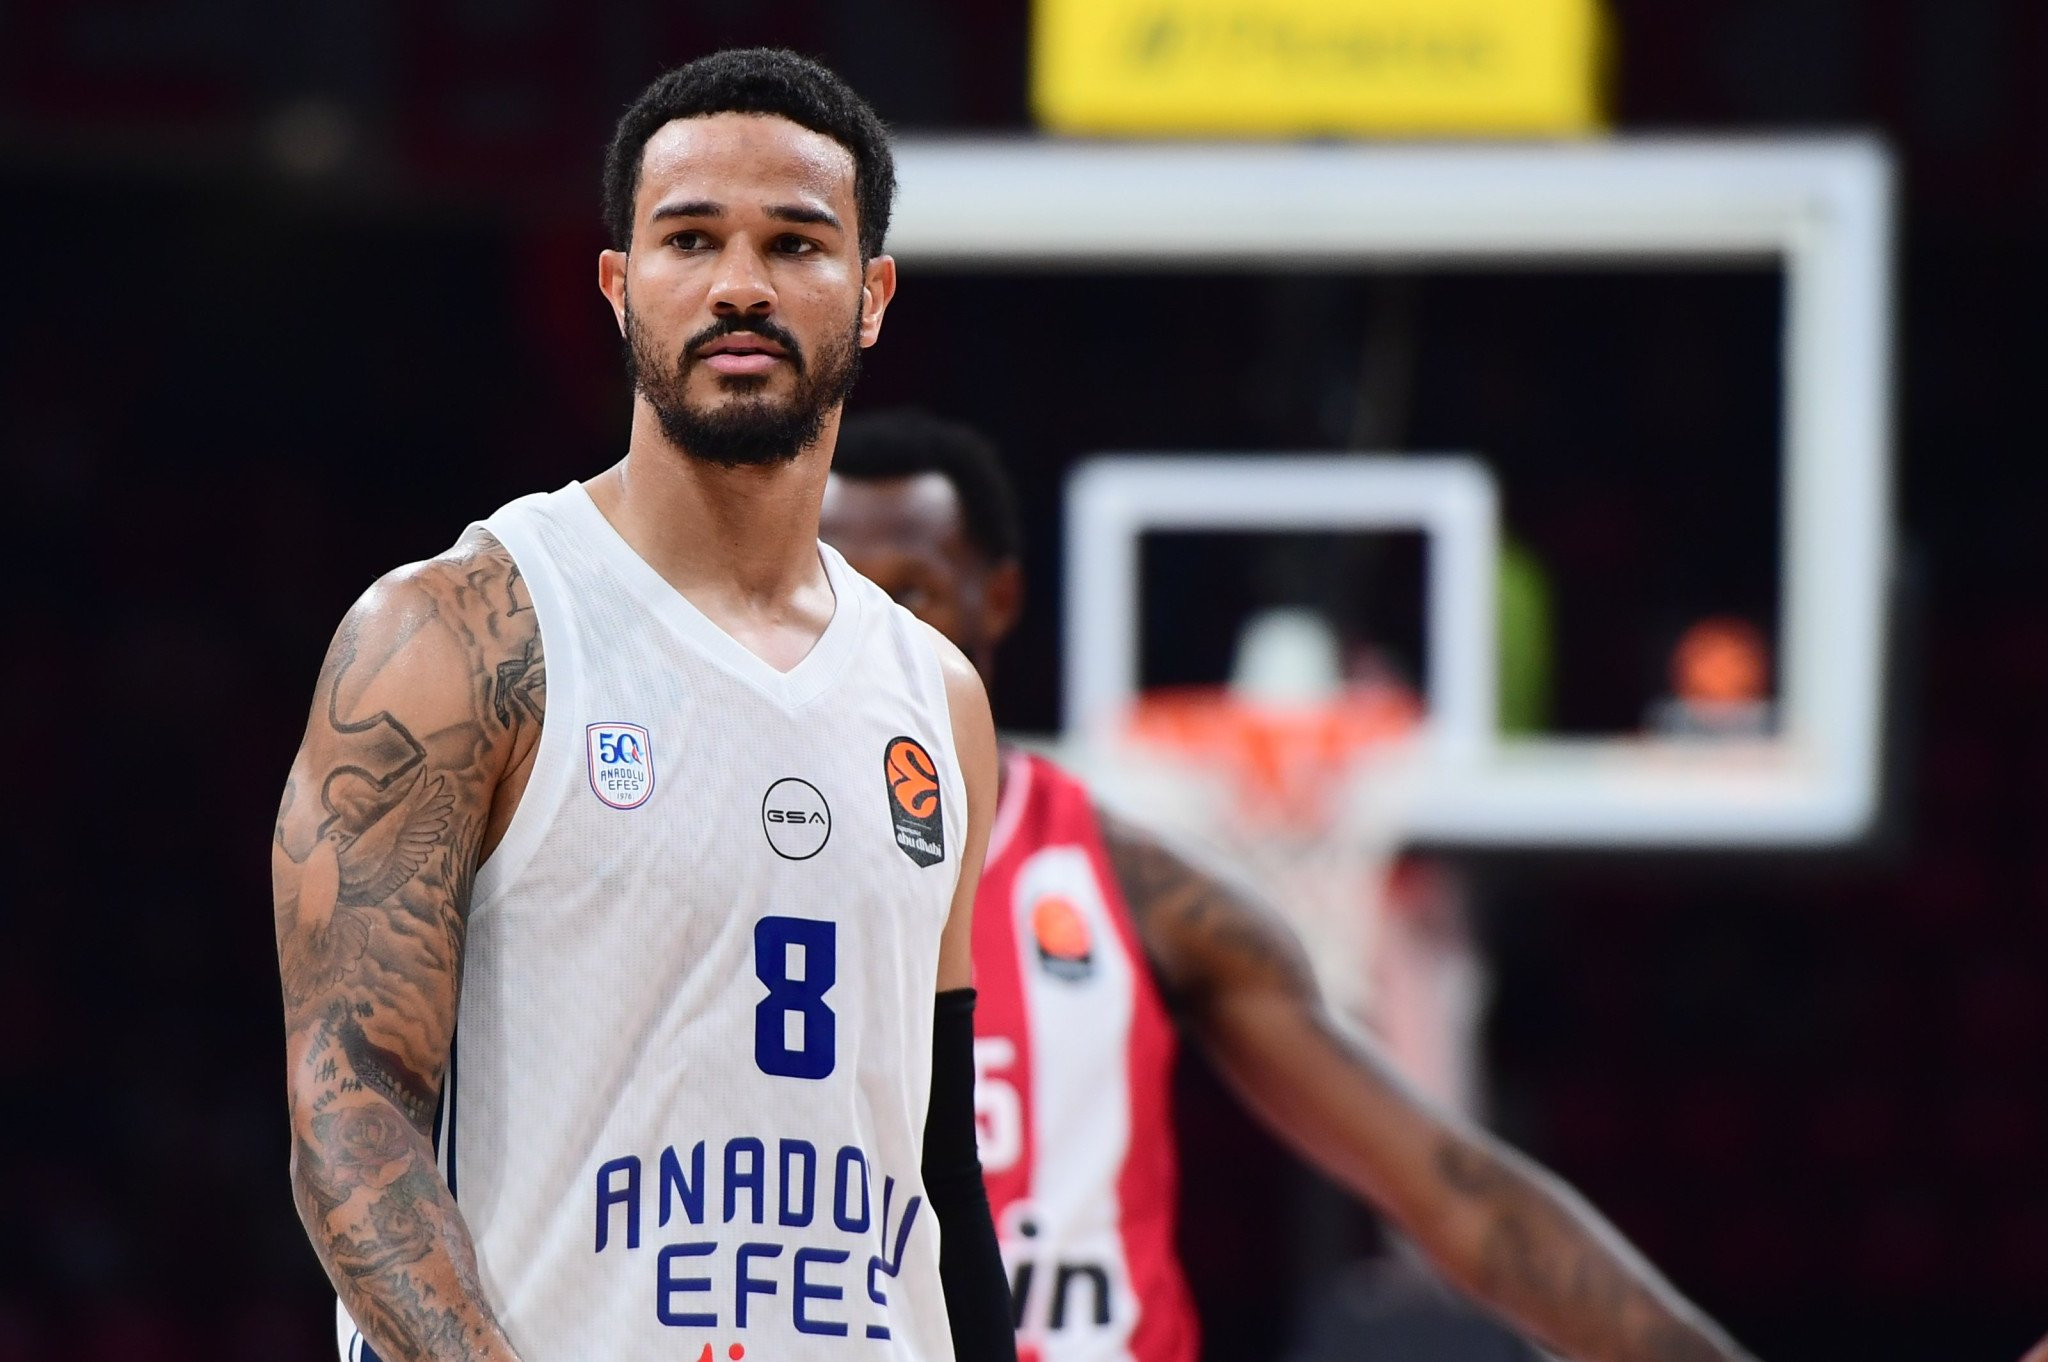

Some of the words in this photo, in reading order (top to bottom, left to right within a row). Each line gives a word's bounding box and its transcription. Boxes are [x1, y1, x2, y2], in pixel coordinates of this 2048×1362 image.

[600, 732, 642, 765] 50
[600, 768, 644, 782] ANADOLU
[608, 780, 639, 790] EFES
[767, 809, 825, 824] GSA
[754, 915, 836, 1080] 8
[595, 1136, 922, 1277] ANADOU
